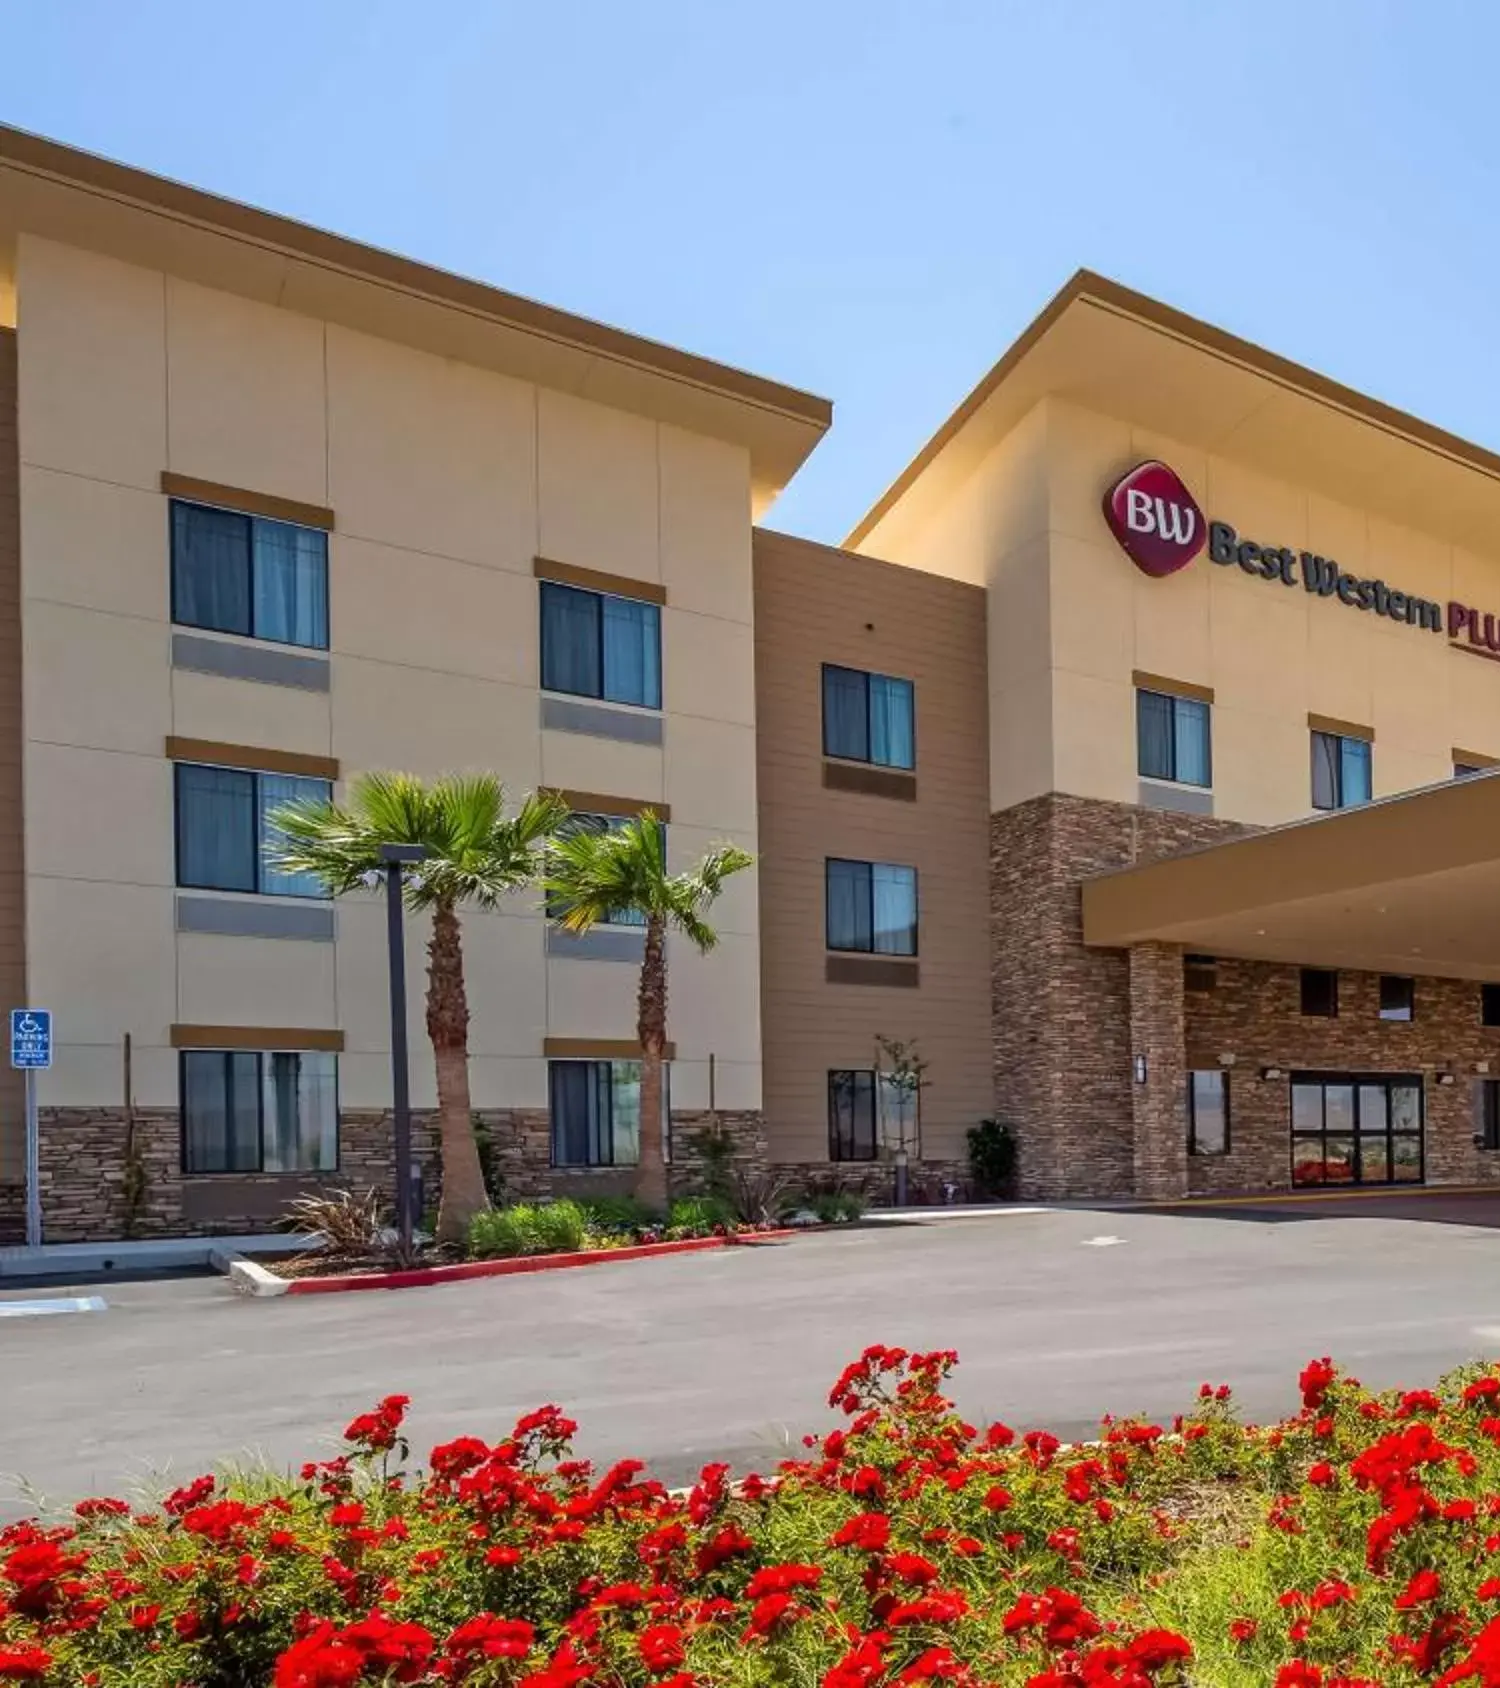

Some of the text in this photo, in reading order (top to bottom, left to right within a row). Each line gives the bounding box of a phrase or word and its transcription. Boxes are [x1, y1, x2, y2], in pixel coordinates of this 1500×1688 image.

[1126, 489, 1195, 545] BW
[1208, 521, 1298, 586] Best
[1301, 552, 1442, 632] Western
